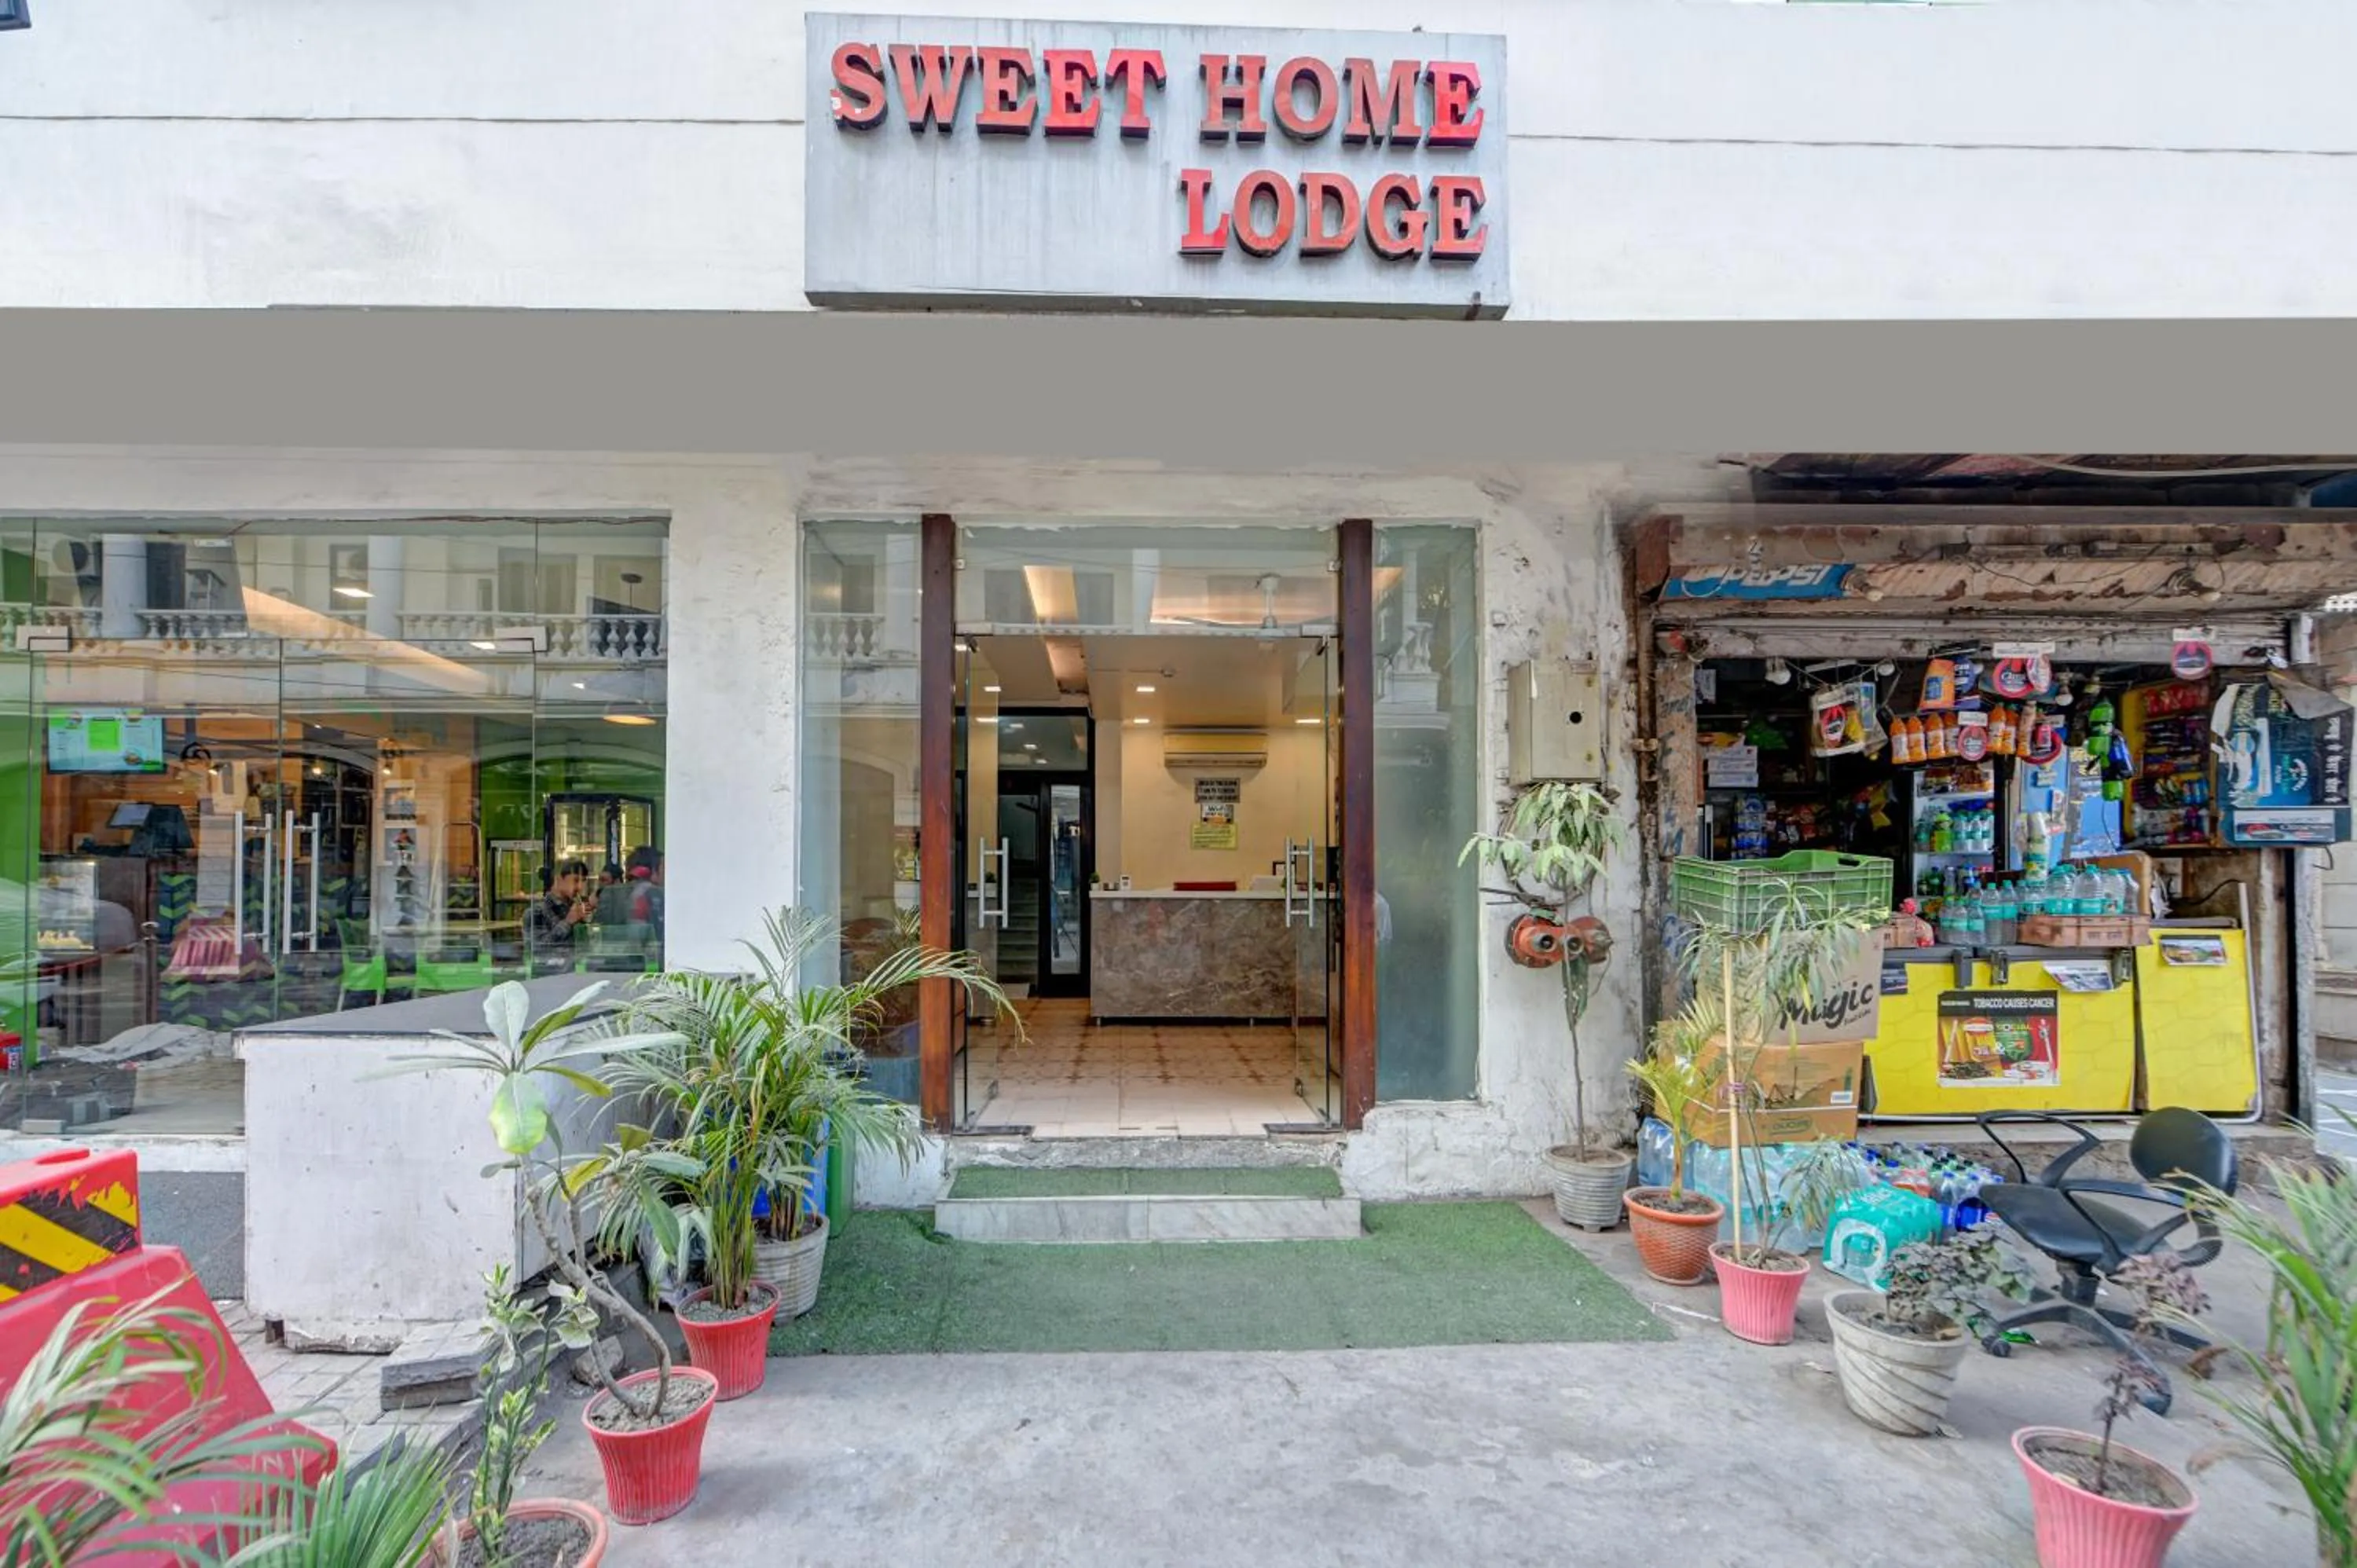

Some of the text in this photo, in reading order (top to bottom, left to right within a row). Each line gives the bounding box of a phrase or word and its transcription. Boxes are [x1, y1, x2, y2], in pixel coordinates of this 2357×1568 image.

[830, 42, 1484, 148] SWEET HOME
[1178, 168, 1487, 262] LODGE
[1721, 565, 1831, 585] PEPSI
[1974, 997, 2002, 1009] TOBACCO
[2003, 997, 2029, 1009] CAUSES
[2029, 997, 2055, 1009] CANCER
